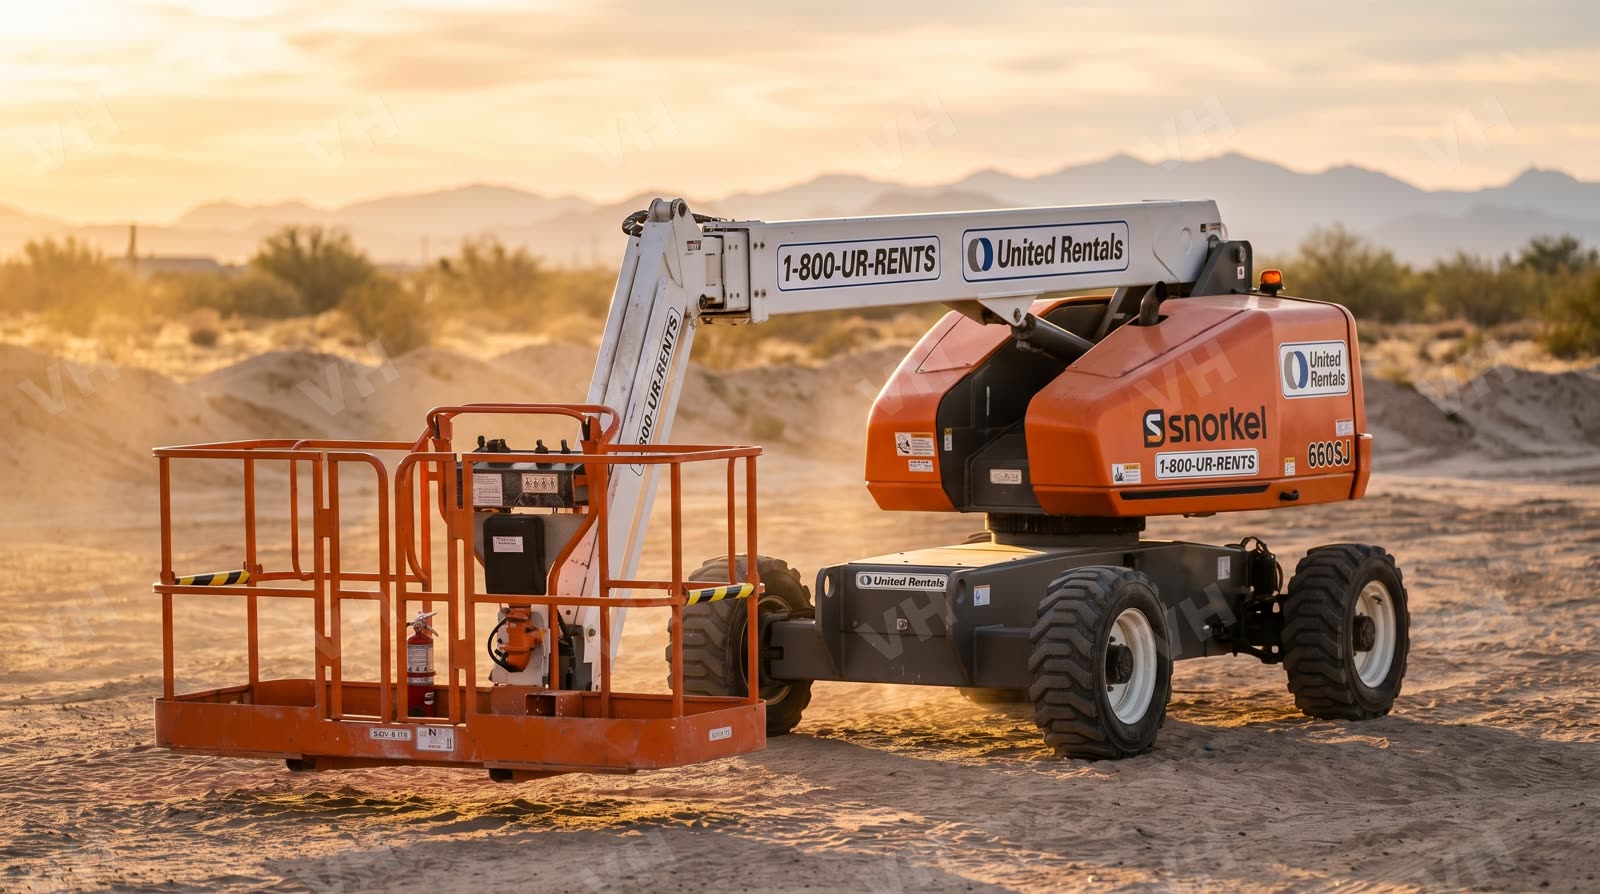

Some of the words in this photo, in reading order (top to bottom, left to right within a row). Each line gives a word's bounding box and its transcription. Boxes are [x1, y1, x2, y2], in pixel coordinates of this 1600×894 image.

[997, 236, 1056, 268] United
[1060, 232, 1124, 263] Rentals
[783, 244, 936, 282] 1-800-UR-RENTS
[1309, 350, 1341, 369] United
[1311, 369, 1346, 388] Rentals
[1168, 405, 1267, 443] snorkel
[1159, 455, 1256, 474] 1-800-UR-RENTS
[1308, 439, 1351, 469] 660SJ
[873, 576, 907, 586] United
[908, 577, 945, 588] Rentals
